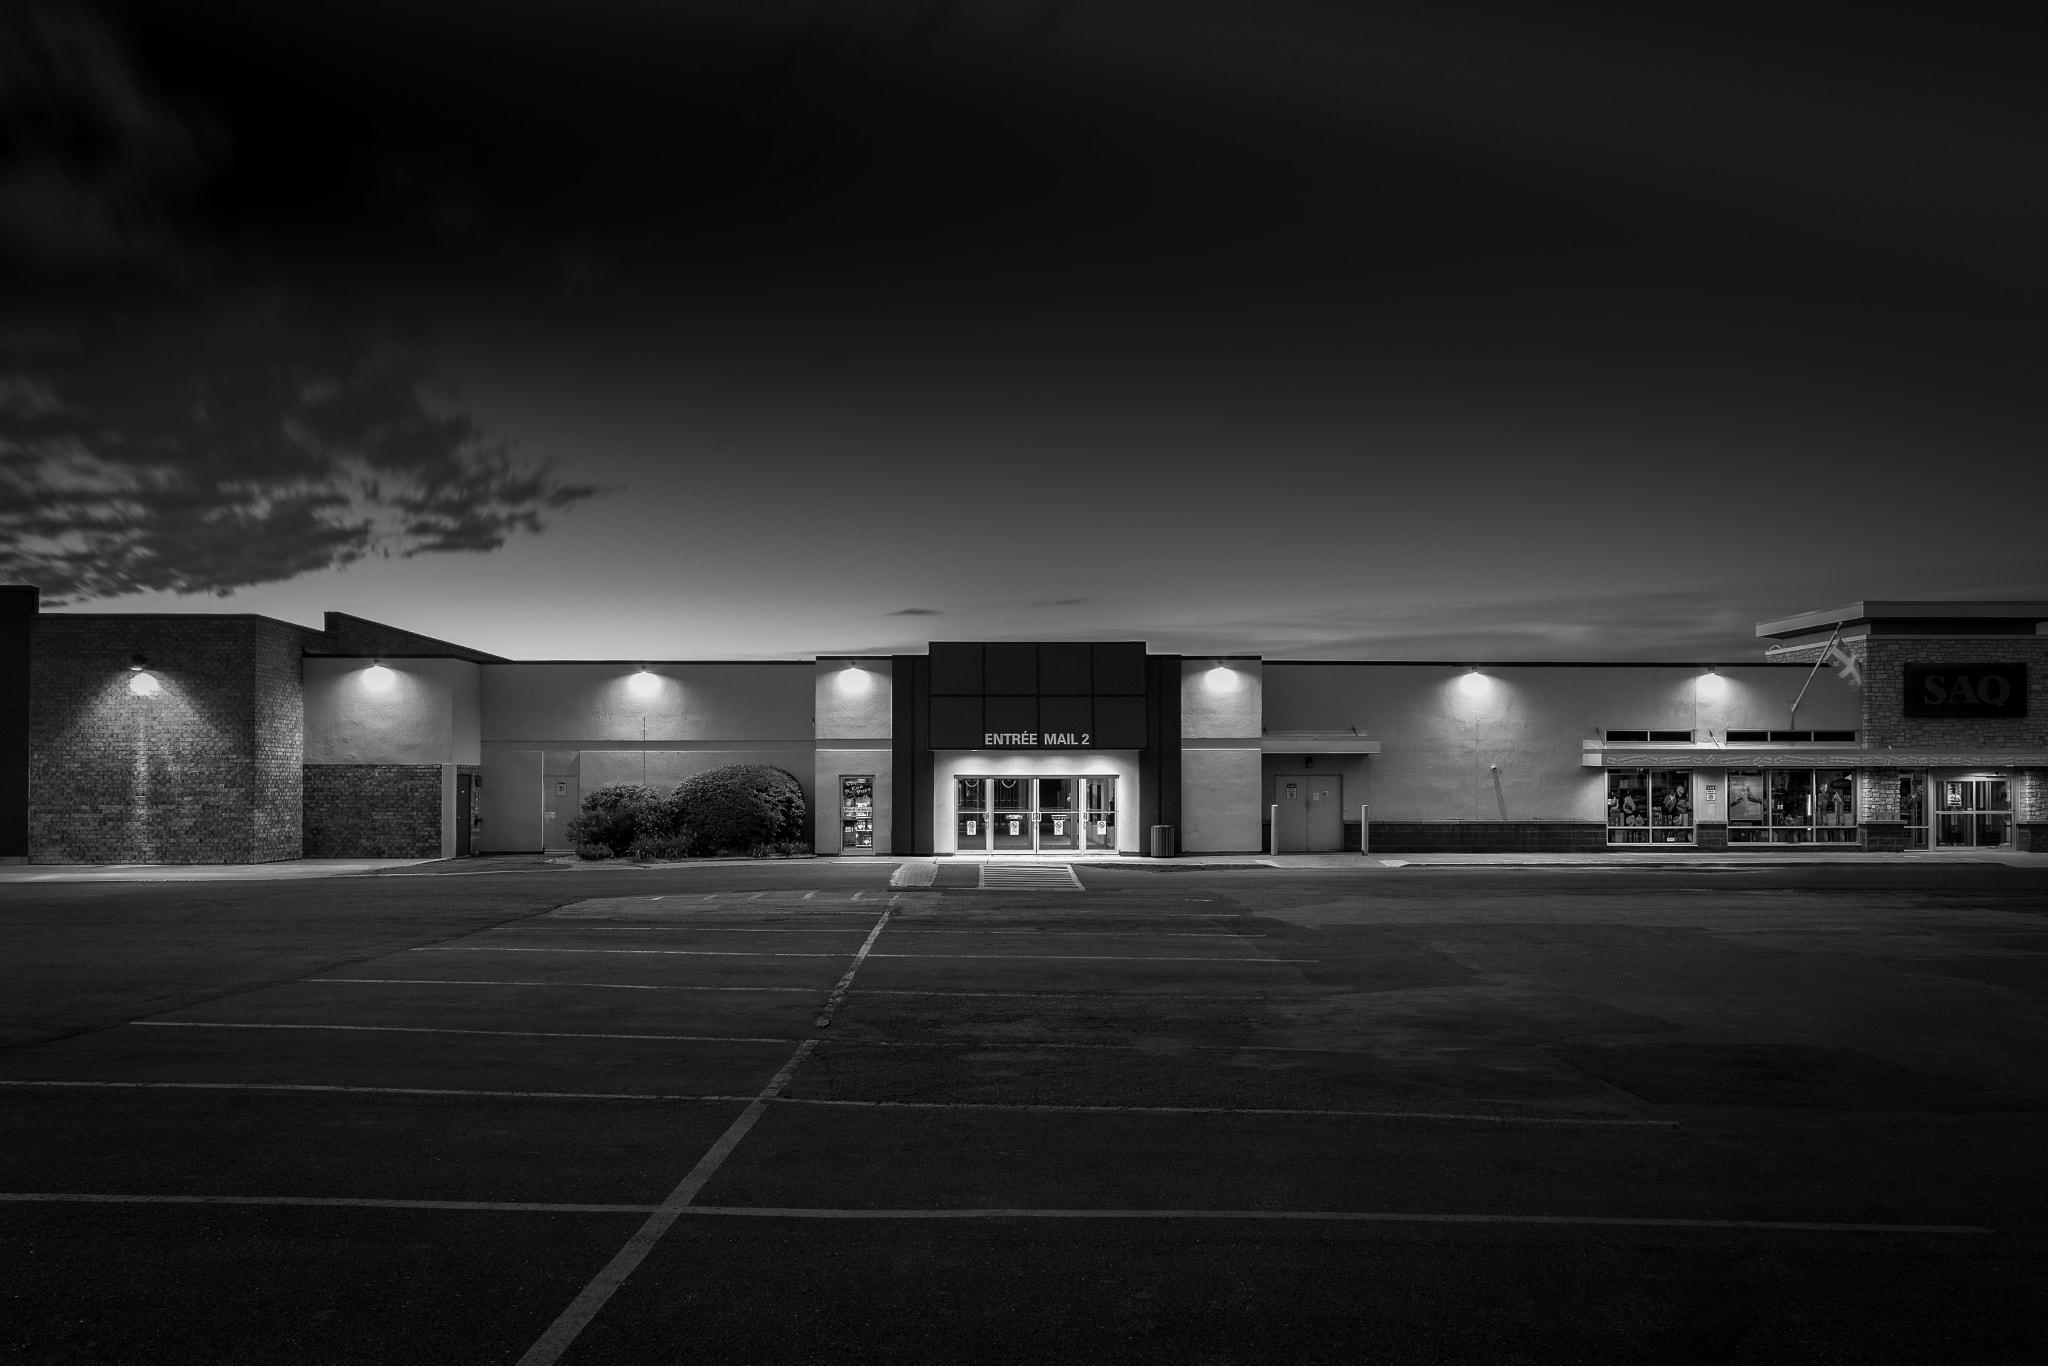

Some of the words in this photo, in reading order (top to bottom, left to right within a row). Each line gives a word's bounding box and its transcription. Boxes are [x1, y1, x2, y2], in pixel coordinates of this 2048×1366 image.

[1923, 674, 2012, 707] SAQ
[984, 730, 1038, 745] ENTRÉE
[1044, 733, 1079, 745] MAIL
[1081, 733, 1090, 745] 2
